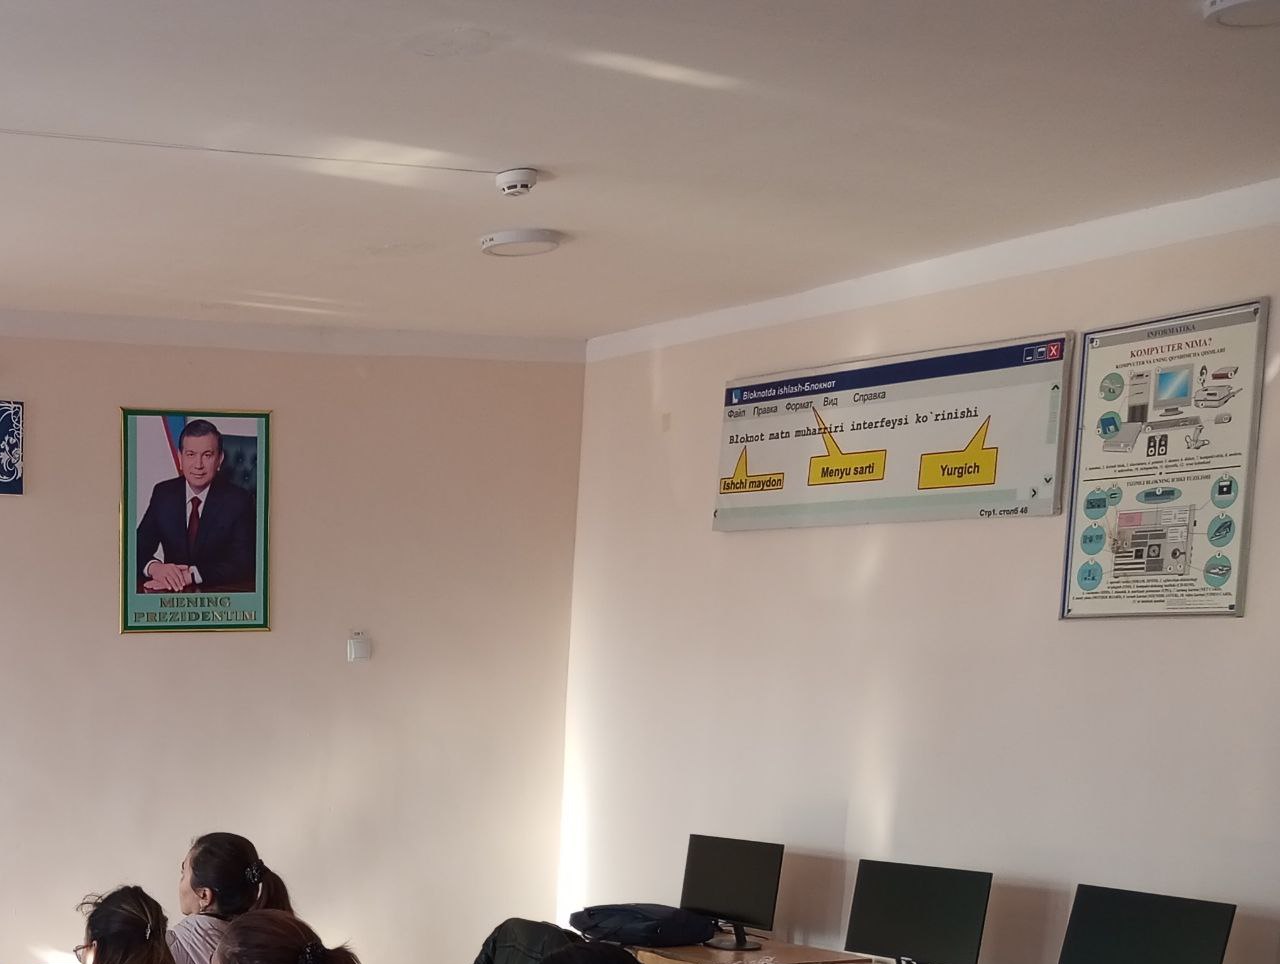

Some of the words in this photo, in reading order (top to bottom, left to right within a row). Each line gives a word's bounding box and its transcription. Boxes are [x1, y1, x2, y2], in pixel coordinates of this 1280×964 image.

[1130, 340, 1183, 358] KOMPYUTER
[1185, 337, 1213, 350] NIMA?
[742, 387, 776, 400] Bloknotda
[727, 408, 746, 418] Файл
[752, 404, 778, 417] Правка
[785, 399, 813, 413] Формат
[823, 396, 838, 407] Вид
[853, 390, 886, 404] Справка
[729, 432, 765, 445] Bloknot
[768, 429, 790, 440] matn
[850, 414, 909, 432] interfeysi
[821, 466, 851, 480] Menyu
[940, 462, 980, 478] Yurgich
[722, 479, 747, 491] Ishchi
[748, 477, 783, 491] maydon
[160, 596, 231, 608] MENING
[133, 610, 257, 623] PREZIDENTIM
